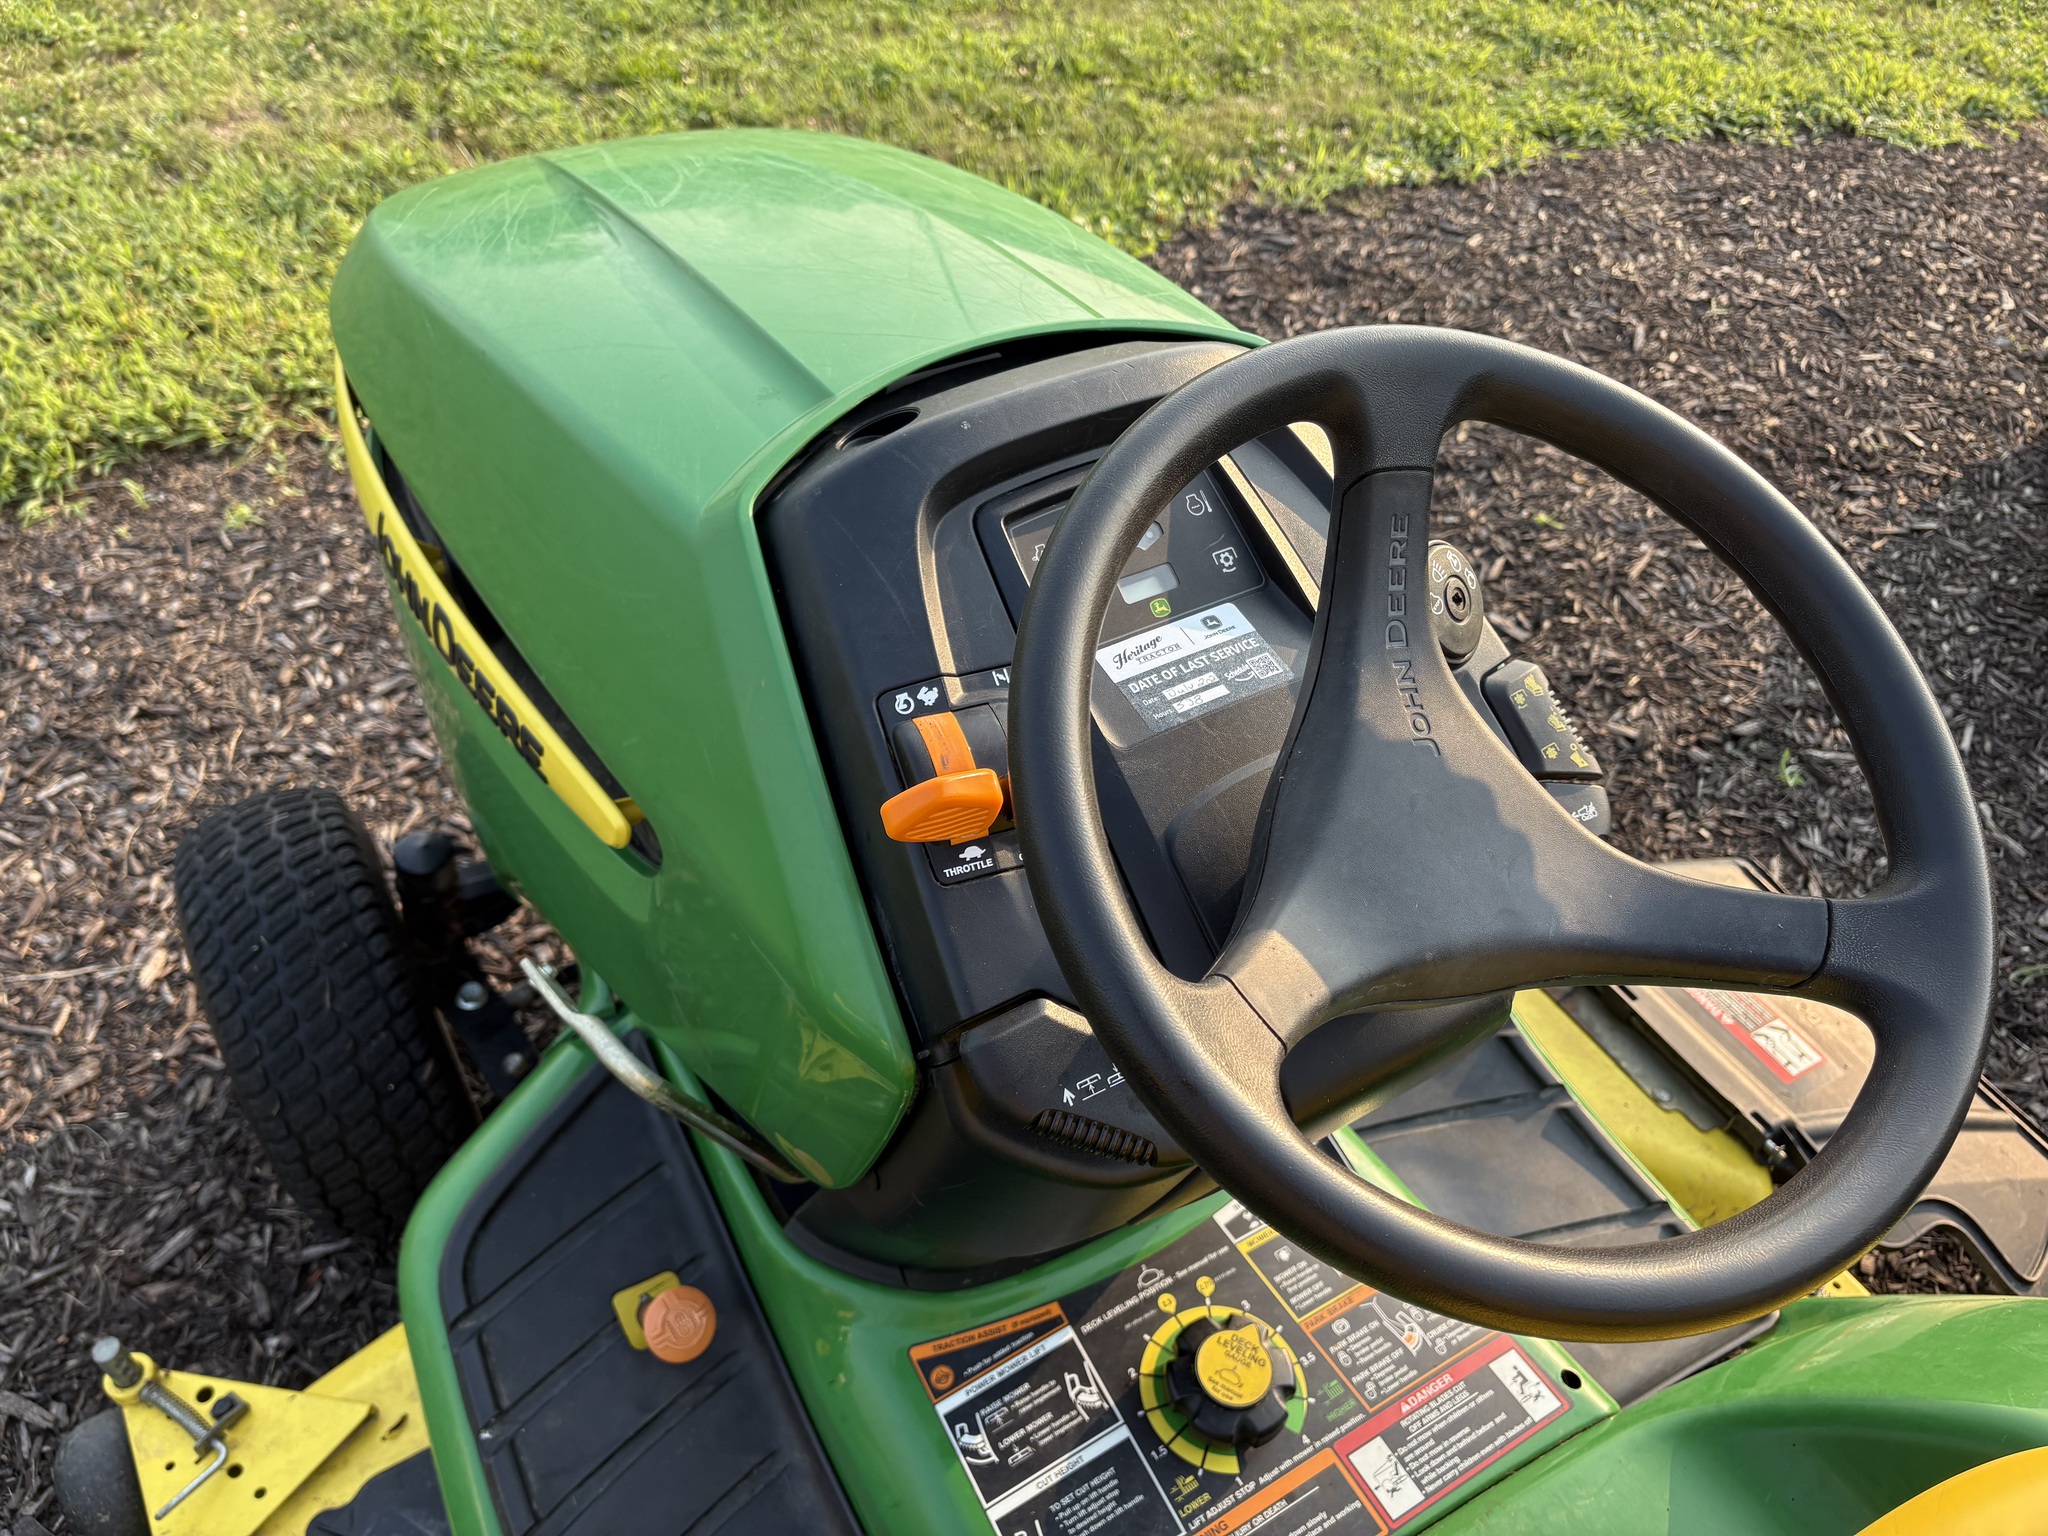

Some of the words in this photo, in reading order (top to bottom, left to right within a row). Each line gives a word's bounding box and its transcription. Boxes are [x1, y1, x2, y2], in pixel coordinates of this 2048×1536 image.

[1386, 514, 1409, 650] DEERE
[1204, 631, 1219, 640] JOHN
[1217, 625, 1236, 635] DEERE
[1113, 634, 1163, 669] Heritage
[1128, 674, 1161, 694] DATE
[1164, 668, 1180, 681] OF
[1179, 655, 1209, 676] LAST
[1207, 638, 1260, 662] SERVICE
[1136, 643, 1182, 665] TRACTOR
[1224, 664, 1250, 681] Schedule
[433, 602, 549, 785] DEERE
[1393, 660, 1440, 756] JOHN
[943, 858, 993, 878] THROTTLE
[1080, 1316, 1104, 1335] DECK
[1101, 1295, 1140, 1323] LEVELING
[1137, 1275, 1174, 1302] POSITION
[1304, 1314, 1327, 1330] PARK
[1327, 1296, 1354, 1316] BRAKE
[931, 1332, 975, 1353] TRACTION
[975, 1323, 1007, 1339] ASSIST
[1216, 1336, 1266, 1367] LEVELING
[1231, 1333, 1258, 1354] DECK
[1328, 1338, 1349, 1355] PARK
[1347, 1324, 1370, 1343] BRAKE
[1367, 1318, 1380, 1330] ON
[963, 1373, 996, 1396] POWER
[994, 1353, 1029, 1378] MOWER
[1027, 1343, 1046, 1358] LIFT
[1128, 1367, 1138, 1380] 2
[1224, 1350, 1253, 1368] GAUGE
[1300, 1352, 1316, 1368] 3.5
[1350, 1368, 1371, 1385] PARK
[1368, 1354, 1393, 1374] BRAKE
[1390, 1346, 1406, 1359] OFF
[978, 1398, 1003, 1417] RAISE
[1001, 1381, 1031, 1403] MOWER
[1399, 1404, 1431, 1428] ROTATING
[1428, 1388, 1455, 1409] BLADES
[1451, 1380, 1467, 1393] CUT
[1405, 1371, 1454, 1408] DANGER
[1324, 1397, 1357, 1423] HIGHER
[1396, 1445, 1407, 1455] Do
[1405, 1438, 1418, 1449] not
[1416, 1428, 1433, 1442] mow
[1430, 1418, 1448, 1433] when
[1446, 1404, 1470, 1423] children
[1474, 1388, 1495, 1404] others
[1408, 1420, 1423, 1433] OFF
[1420, 1408, 1441, 1425] ARMS
[1438, 1400, 1454, 1413] AND
[1451, 1389, 1470, 1405] LEGS
[996, 1427, 1027, 1449] LOWER
[1024, 1411, 1054, 1432] MOWER
[1301, 1434, 1310, 1445] 4
[1407, 1459, 1418, 1469] Do
[1416, 1451, 1430, 1464] not
[1428, 1442, 1444, 1456] mow
[1447, 1424, 1471, 1443] reverse
[1413, 1462, 1430, 1477] Look
[1428, 1451, 1448, 1467] down
[1445, 1444, 1458, 1456] and
[1455, 1431, 1478, 1449] behind
[1476, 1419, 1495, 1435] before
[1493, 1411, 1507, 1424] and
[1151, 1445, 1168, 1461] 1.5
[1402, 1450, 1416, 1463] are
[1413, 1437, 1436, 1455] around
[1424, 1477, 1444, 1493] Never
[1442, 1466, 1459, 1481] carry
[1456, 1451, 1481, 1471] children
[1479, 1442, 1495, 1456] even
[1492, 1434, 1507, 1446] with
[1505, 1421, 1525, 1438] blades
[1034, 1473, 1054, 1490] CUT
[1052, 1454, 1086, 1479] HEIGHT
[1186, 1513, 1207, 1530] LIFT
[1203, 1494, 1237, 1519] ADJUST
[1234, 1480, 1258, 1500] STOP
[1256, 1466, 1281, 1486] Adjust
[1278, 1457, 1294, 1472] with
[1291, 1443, 1316, 1463] mower
[1320, 1427, 1342, 1445] raised
[1338, 1411, 1368, 1433] position.
[1234, 1476, 1244, 1486] 1
[1419, 1469, 1438, 1485] while
[1435, 1454, 1461, 1475] backing
[1048, 1501, 1061, 1513] TO
[1059, 1492, 1076, 1506] SET
[1074, 1483, 1090, 1496] CUT
[1088, 1466, 1117, 1487] HEIGHT
[1058, 1506, 1072, 1519] Pull
[1071, 1501, 1081, 1511] up
[1080, 1495, 1090, 1505] on
[1087, 1490, 1099, 1500] lift
[1096, 1477, 1120, 1494] handle
[1062, 1513, 1079, 1526] Turn
[1077, 1507, 1088, 1517] lift
[1085, 1496, 1106, 1512] adjust
[1104, 1487, 1121, 1501] stop
[1176, 1490, 1212, 1518] LOWER
[1074, 1512, 1099, 1530] desired
[1096, 1499, 1118, 1516] height
[1087, 1516, 1107, 1532] down
[1105, 1511, 1116, 1521] on
[1113, 1505, 1124, 1516] lift
[1121, 1492, 1145, 1510] handle
[1199, 1520, 1229, 1536] NING
[1229, 1521, 1252, 1536] JURY
[1252, 1515, 1264, 1527] OR
[1263, 1499, 1288, 1521] DEATH
[1306, 1511, 1328, 1530] slowly
[1322, 1517, 1337, 1529] and
[1336, 1499, 1362, 1523] working
